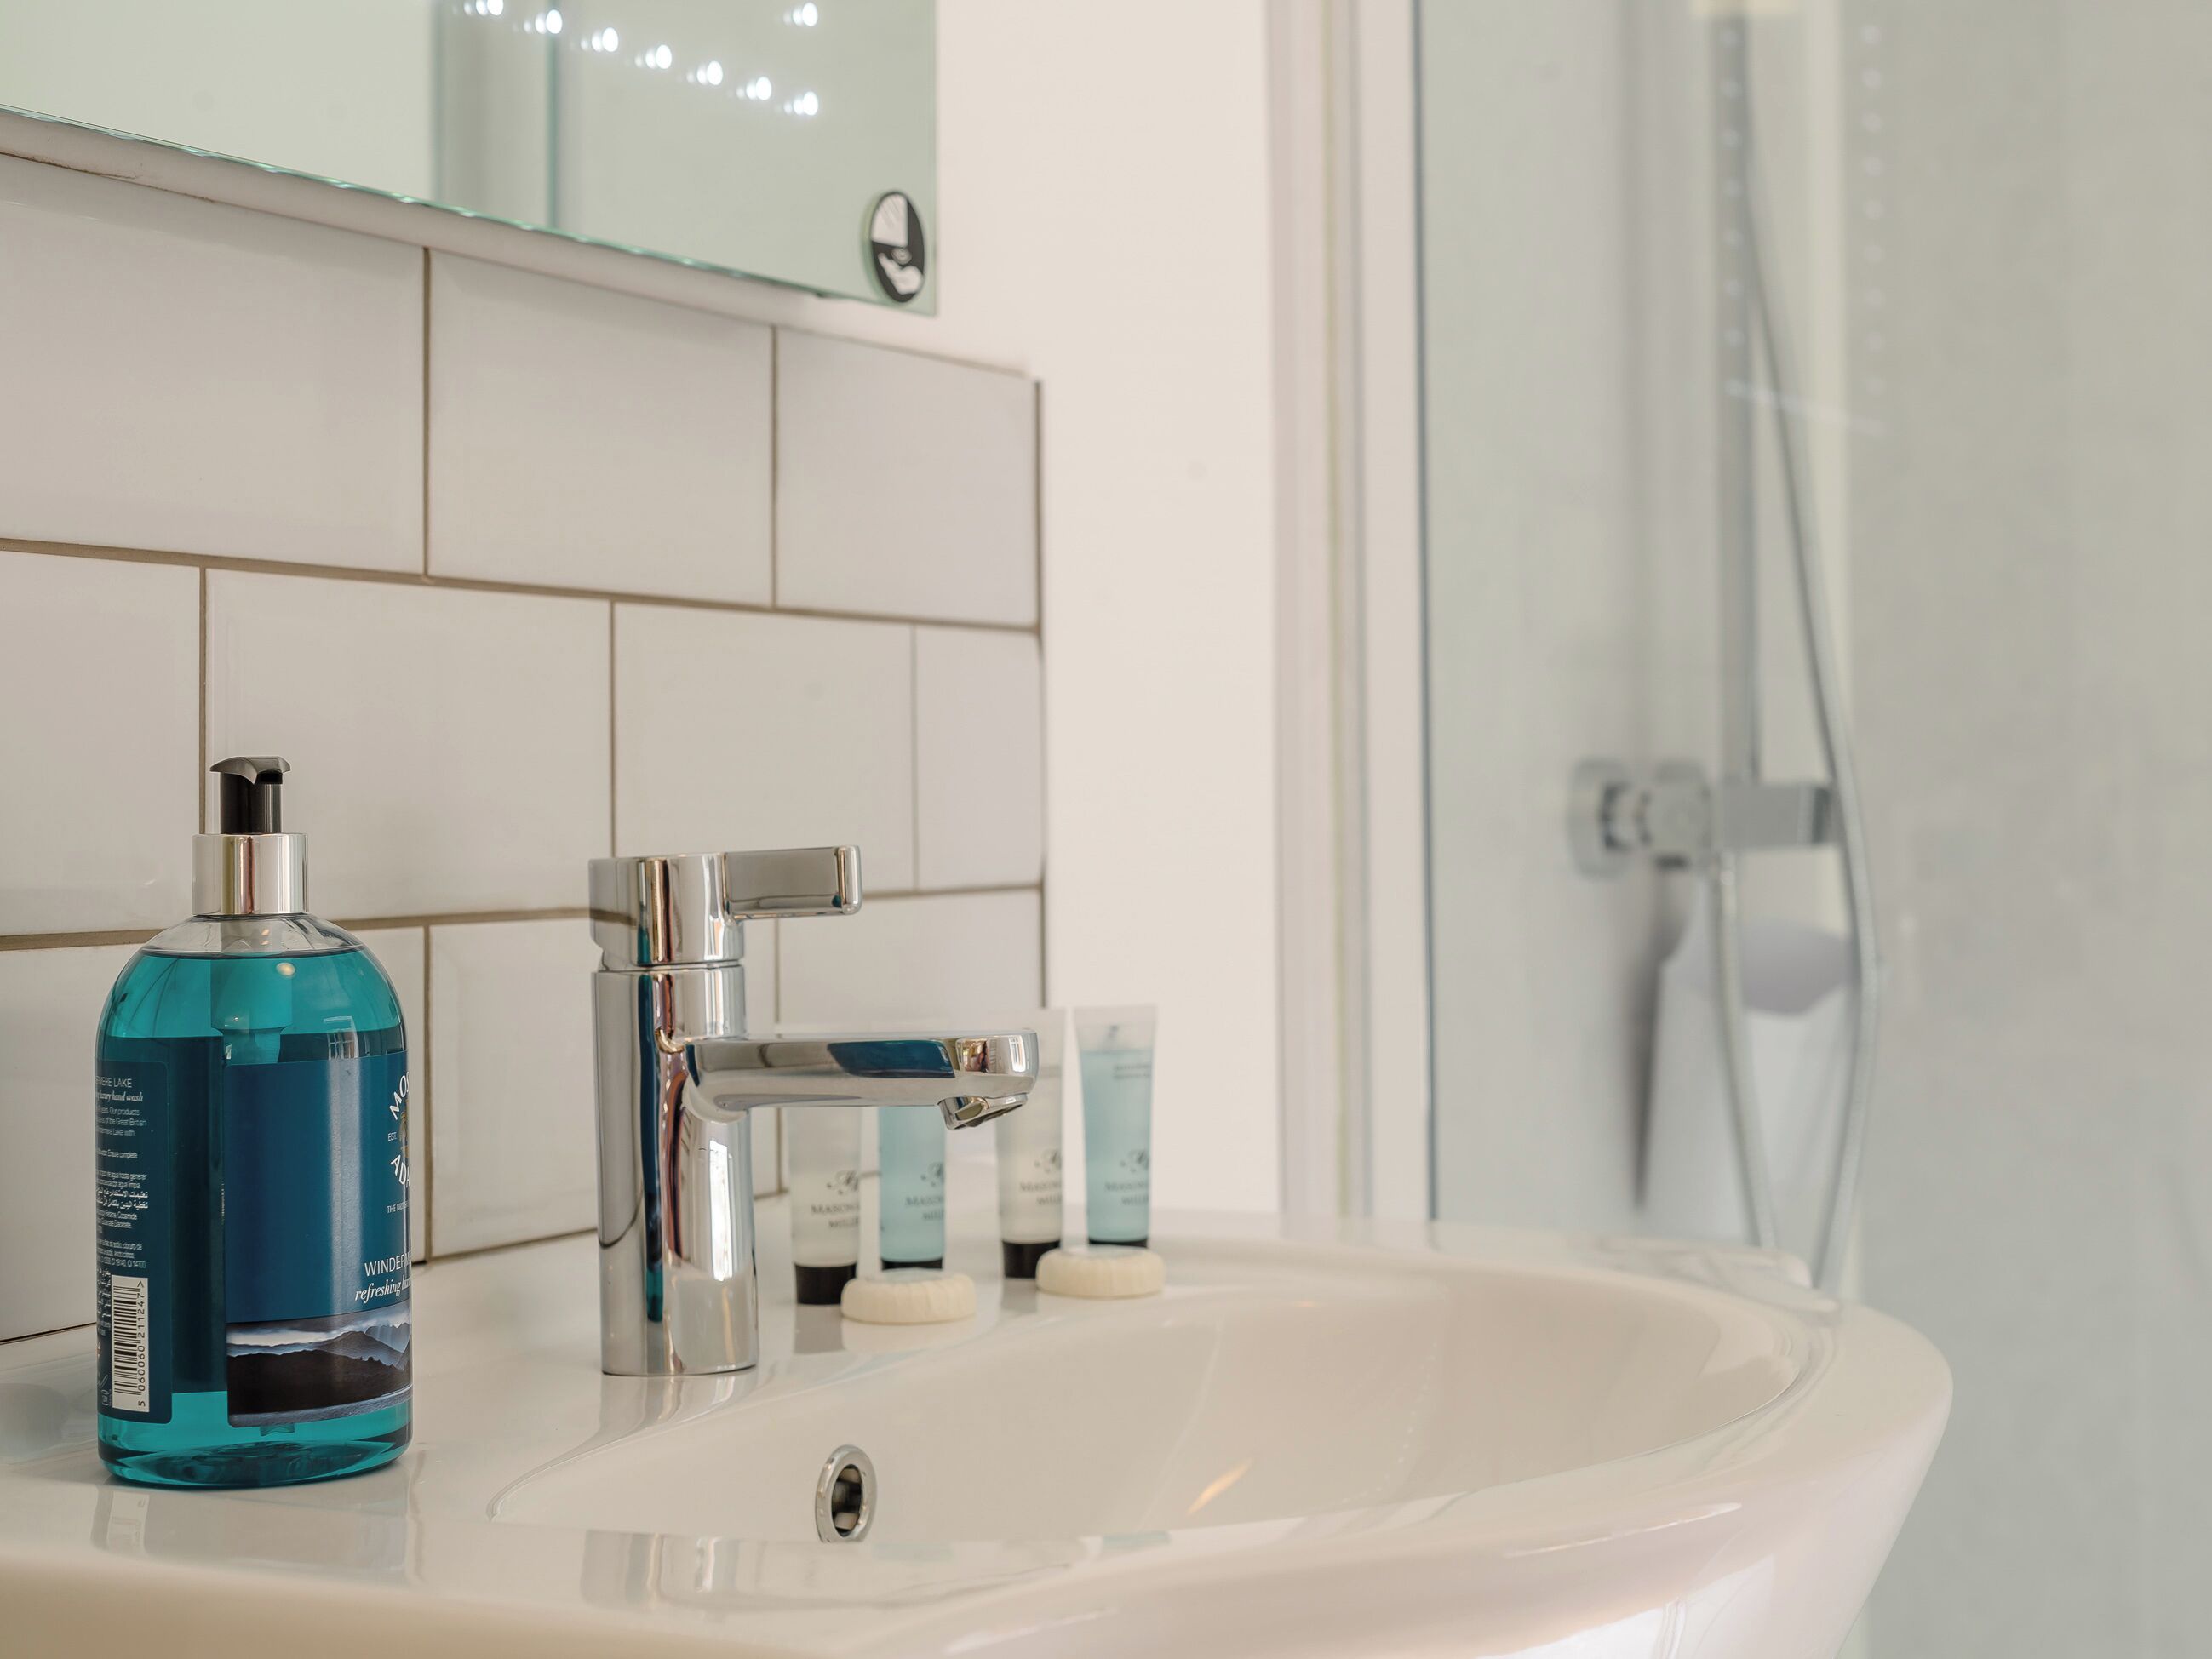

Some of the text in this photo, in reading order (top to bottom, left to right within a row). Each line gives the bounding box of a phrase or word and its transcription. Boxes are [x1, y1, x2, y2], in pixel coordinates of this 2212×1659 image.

[113, 1078, 132, 1088] LAKE
[112, 1090, 126, 1101] hand
[126, 1090, 144, 1101] wash
[387, 1204, 397, 1213] THE
[354, 1279, 402, 1304] refreshing
[137, 1292, 146, 1339] 211247
[137, 1345, 146, 1392] 060060
